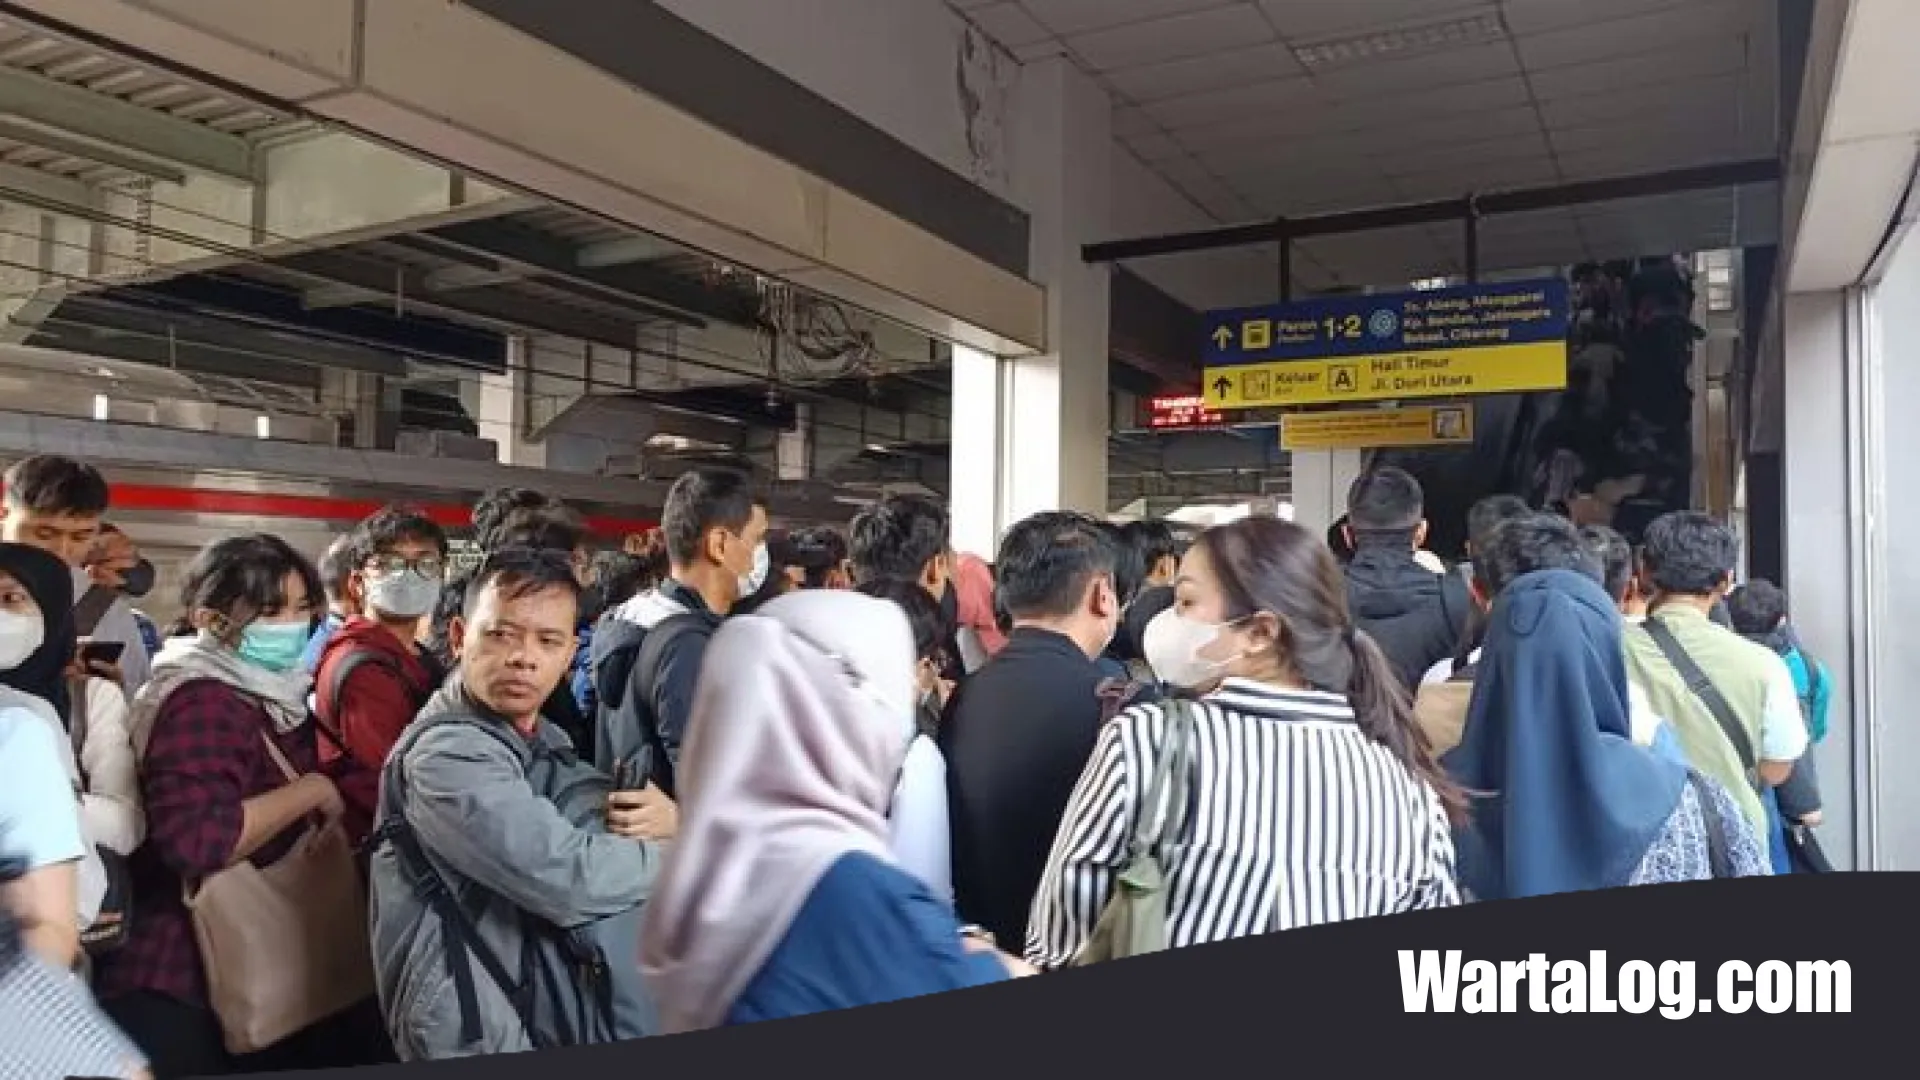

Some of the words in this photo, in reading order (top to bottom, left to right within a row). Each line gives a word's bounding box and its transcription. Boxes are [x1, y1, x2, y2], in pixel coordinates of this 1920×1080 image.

[1406, 356, 1449, 370] Timur
[1275, 371, 1320, 383] Keluar
[1335, 369, 1352, 388] A
[1430, 373, 1475, 388] Utara
